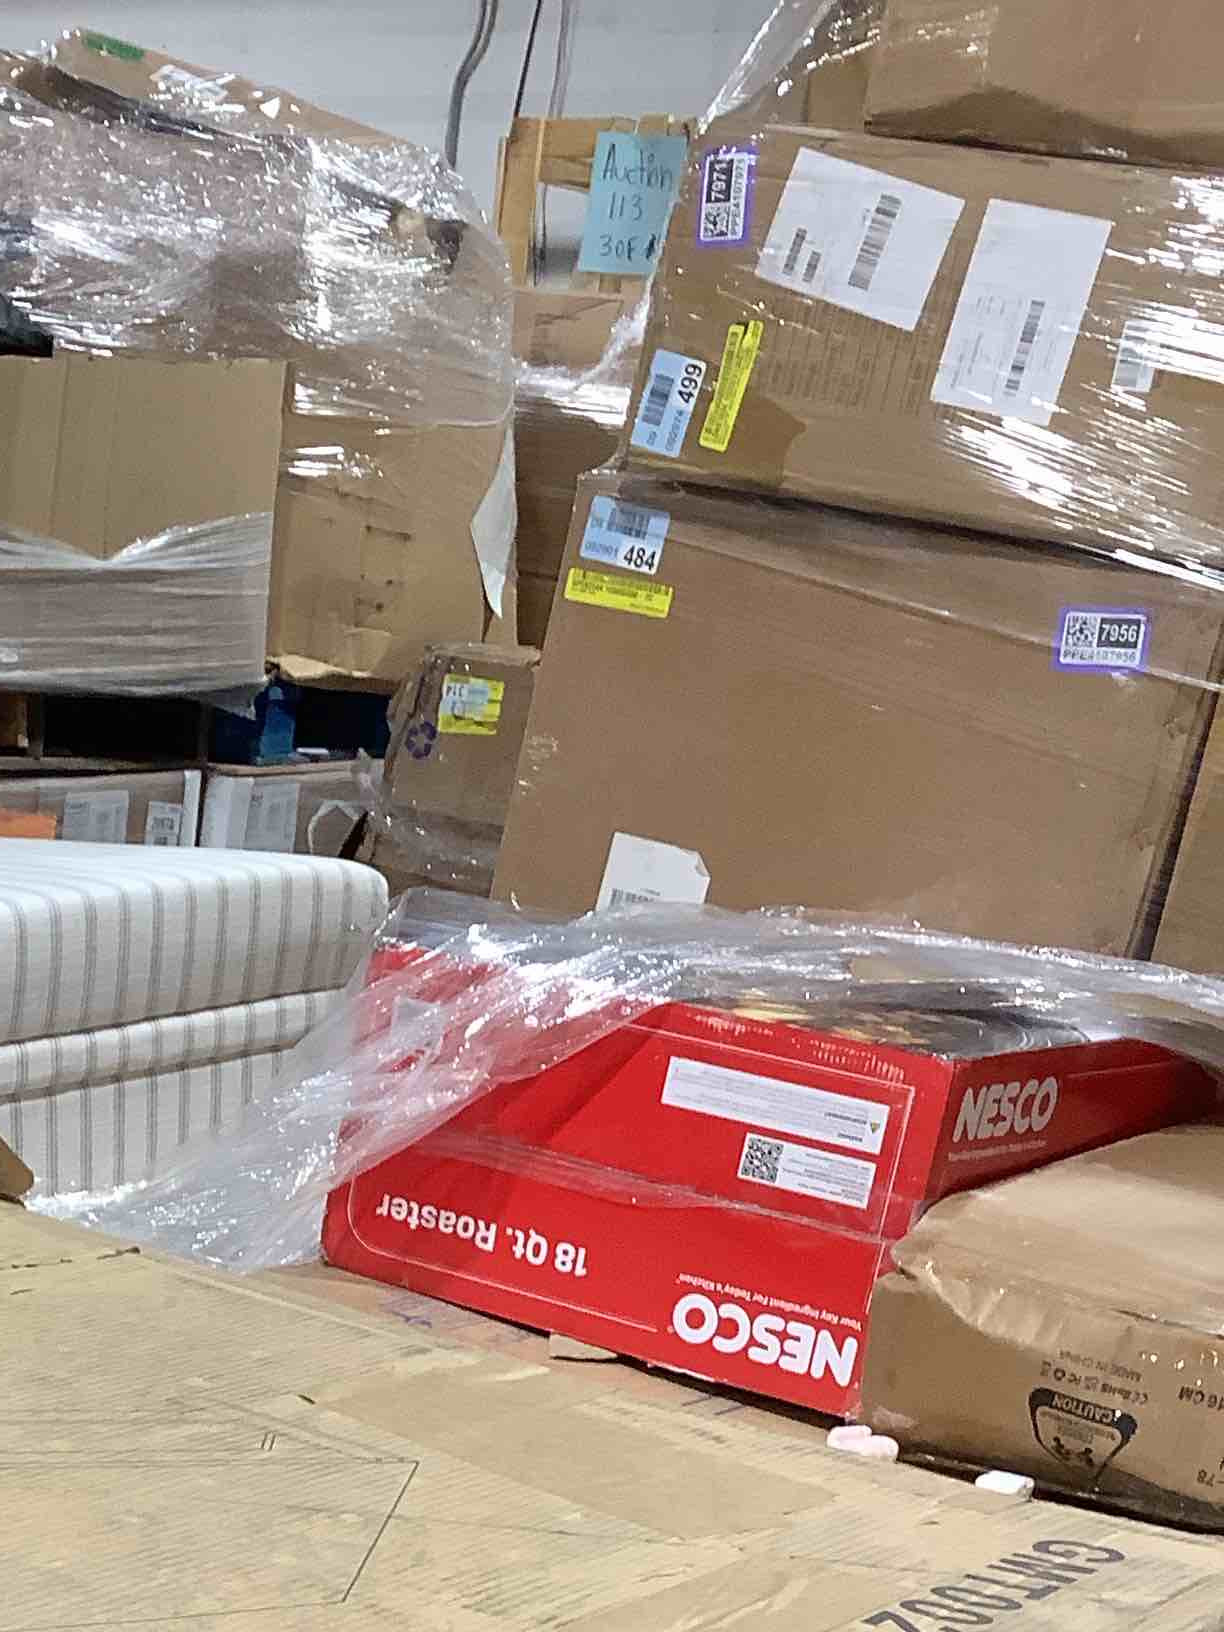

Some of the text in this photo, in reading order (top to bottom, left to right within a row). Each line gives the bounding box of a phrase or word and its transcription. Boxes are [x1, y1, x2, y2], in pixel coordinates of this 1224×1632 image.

[602, 143, 673, 191] Auction
[710, 158, 730, 202] 7971
[677, 363, 703, 405] 499
[623, 545, 656, 571] 484
[1100, 623, 1138, 642] 7956
[951, 1075, 1060, 1144] NESCO
[371, 1189, 592, 1278] 18 Qt. Roaster
[664, 1287, 862, 1389] NESCO
[1052, 1393, 1115, 1422] CAUTION
